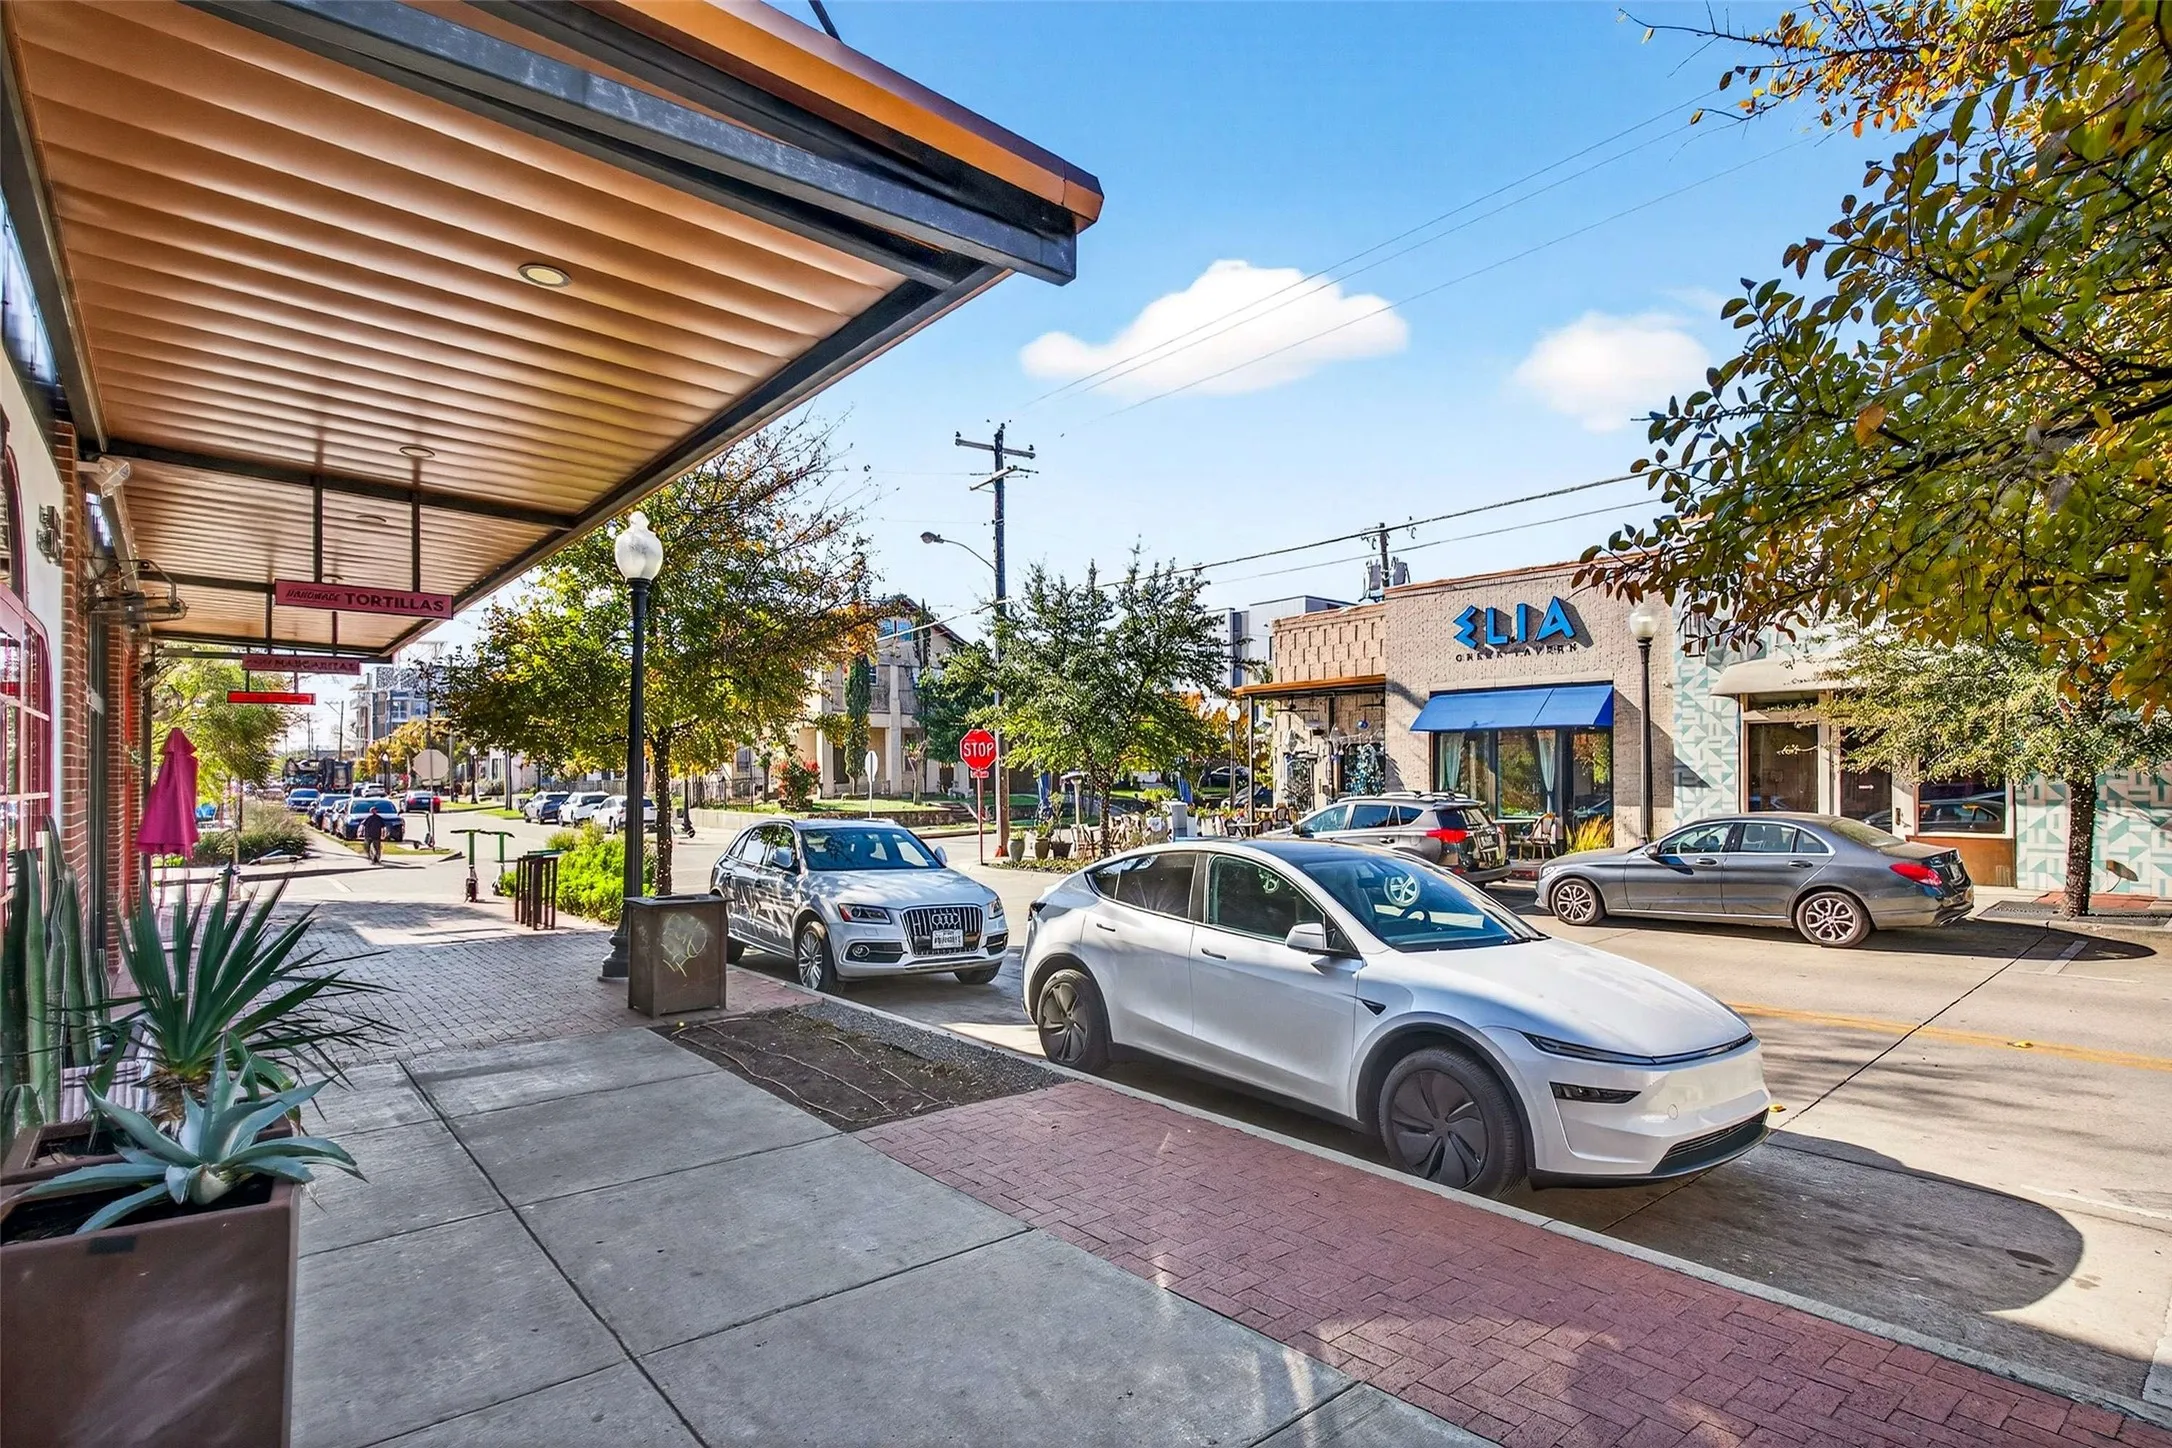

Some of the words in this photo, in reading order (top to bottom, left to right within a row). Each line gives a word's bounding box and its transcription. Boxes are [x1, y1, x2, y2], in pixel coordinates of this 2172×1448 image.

[344, 592, 445, 612] TORTILLAS
[1452, 595, 1577, 650] ELIA
[963, 742, 995, 758] STOP
